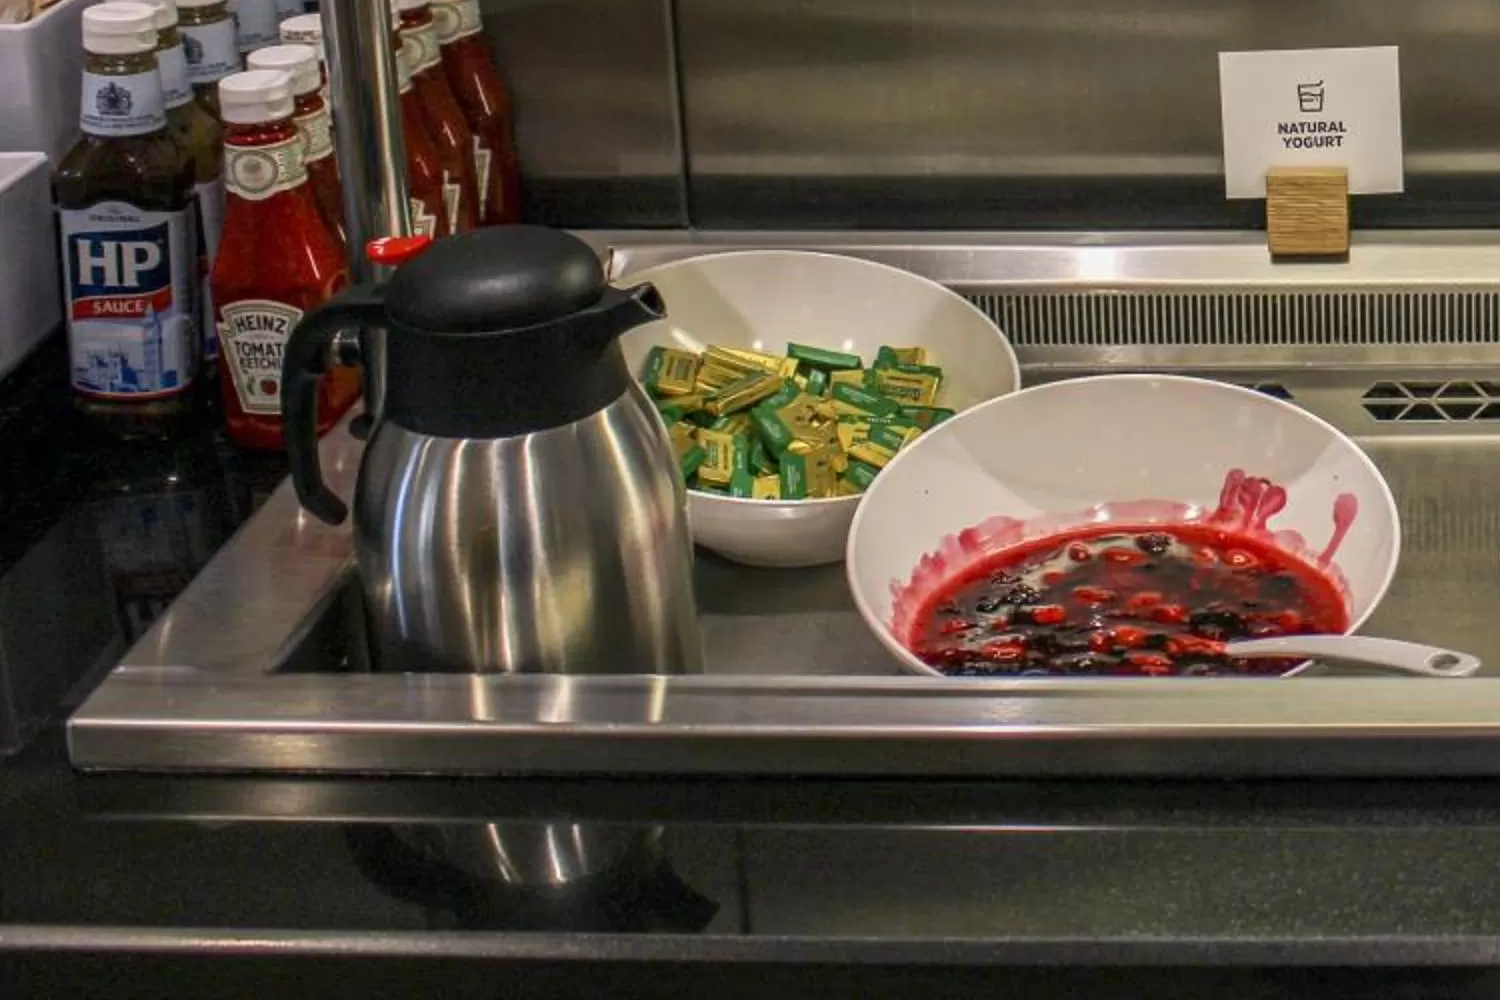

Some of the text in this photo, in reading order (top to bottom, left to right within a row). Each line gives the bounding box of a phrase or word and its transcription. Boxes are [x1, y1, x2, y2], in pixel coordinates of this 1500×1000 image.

[1277, 121, 1347, 134] NATURAL
[1282, 135, 1343, 149] YOGURT
[76, 239, 161, 287] HP
[93, 300, 145, 314] SAUCE
[235, 314, 287, 335] HEINZ
[234, 340, 283, 357] TOMAT
